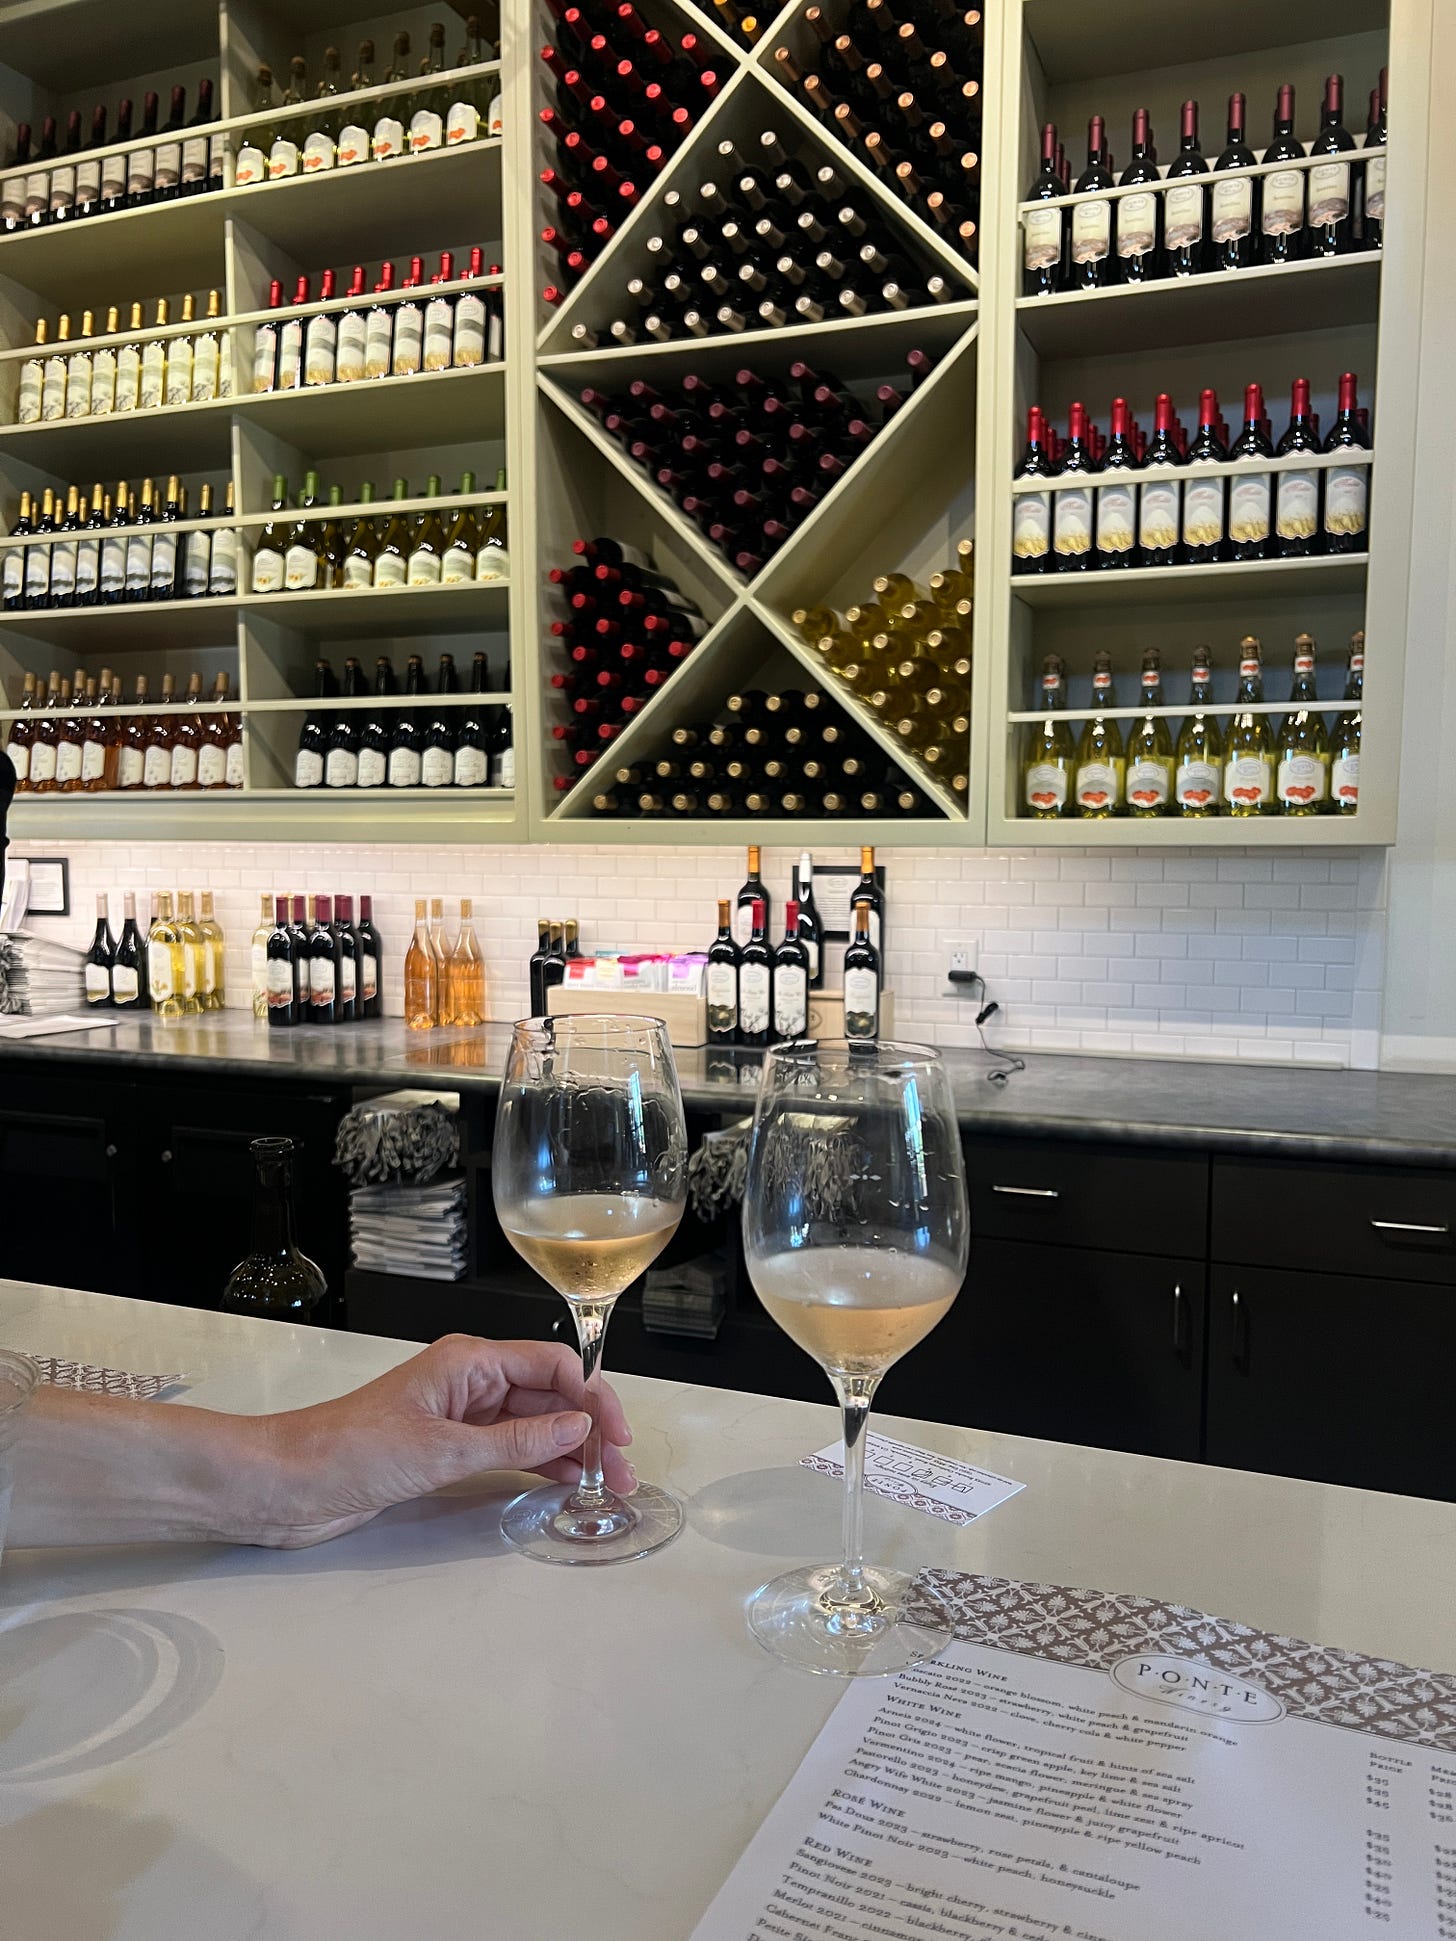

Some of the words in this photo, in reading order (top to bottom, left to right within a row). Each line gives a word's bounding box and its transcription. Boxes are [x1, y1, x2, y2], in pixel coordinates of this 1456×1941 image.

[886, 1694, 925, 1710] WHITE
[929, 1703, 963, 1719] WINE
[898, 1672, 932, 1686] Bubbly
[960, 1688, 987, 1700] 2023
[999, 1698, 1054, 1716] strawberry,
[1058, 1713, 1086, 1723] white
[1088, 1720, 1118, 1729] peach
[1122, 1723, 1129, 1731] &
[1132, 1727, 1188, 1741] grapefruit
[912, 1667, 943, 1678] oscato
[945, 1674, 972, 1685] 2022
[983, 1684, 1018, 1696] orange
[1068, 1705, 1095, 1714] white
[1098, 1712, 1128, 1720] peach
[1144, 1719, 1196, 1733] mandarin
[1200, 1731, 1238, 1746] orange
[976, 1668, 1009, 1682] WINE
[878, 1706, 912, 1719] Arneis
[914, 1715, 941, 1728] 2024
[954, 1726, 981, 1737] white
[1024, 1745, 1066, 1759] tropical
[1069, 1754, 1094, 1765] fruit
[1156, 1771, 1173, 1779] sea
[1176, 1776, 1195, 1784] salt
[894, 1681, 940, 1698] Vernaccia
[943, 1693, 968, 1704] Nera
[971, 1701, 998, 1712] 2022
[1043, 1719, 1077, 1733] cherry
[1079, 1729, 1100, 1737] cola
[1103, 1731, 1111, 1739] &
[1115, 1735, 1144, 1743] white
[1146, 1740, 1186, 1751] pepper
[863, 1736, 924, 1757] Vermentino
[928, 1755, 956, 1768] 2024
[969, 1767, 992, 1776] ripe
[1038, 1785, 1095, 1800] pineapple
[1111, 1798, 1142, 1809] white
[1145, 1804, 1182, 1818] flower
[867, 1726, 895, 1738] Pinot
[899, 1733, 921, 1744] Gris
[923, 1741, 952, 1755] 2023
[995, 1762, 1027, 1773] acacia
[1071, 1780, 1126, 1793] meringue
[1129, 1788, 1138, 1796] &
[1162, 1797, 1193, 1810] spray
[873, 1716, 901, 1728] Pinot
[904, 1723, 938, 1737] Grigio
[940, 1733, 968, 1747] 2023
[981, 1746, 1007, 1758] crisp
[1008, 1754, 1040, 1765] green
[1043, 1762, 1076, 1774] apple,
[1080, 1768, 1098, 1778] key
[1100, 1771, 1126, 1781] lime
[1129, 1776, 1137, 1784] &
[1141, 1780, 1159, 1788] sea
[1161, 1784, 1181, 1793] salt
[831, 1788, 865, 1806] ROSÉ
[870, 1799, 907, 1818] WINE
[844, 1768, 909, 1794] Chardonnay
[912, 1789, 942, 1802] 2022
[955, 1799, 991, 1815] lemon
[1022, 1819, 1081, 1835] pineapple
[1096, 1834, 1121, 1844] ripe
[1124, 1841, 1162, 1854] yellow
[1165, 1851, 1201, 1865] peach
[848, 1758, 881, 1772] Angry
[885, 1765, 908, 1778] Wife
[911, 1774, 942, 1789] White
[945, 1785, 975, 1799] 2023
[986, 1796, 1032, 1812] jasmine
[1035, 1807, 1072, 1820] flower
[1074, 1815, 1083, 1823] &
[1085, 1818, 1116, 1832] juicy
[1117, 1826, 1179, 1845] grapefruit
[856, 1747, 907, 1766] Pastorello
[909, 1762, 939, 1776] 2023
[1011, 1791, 1069, 1807] grapefruit
[1104, 1808, 1131, 1819] lime
[1133, 1816, 1155, 1825] zest
[1159, 1820, 1168, 1828] &
[1172, 1825, 1197, 1836] ripe
[1200, 1833, 1244, 1850] apricot
[804, 1836, 831, 1853] RED
[835, 1847, 873, 1868] WINE
[819, 1811, 850, 1828] White
[852, 1823, 883, 1839] Pinot
[886, 1834, 915, 1848] Noir
[917, 1844, 949, 1859] 2023
[963, 1856, 995, 1869] white
[1040, 1873, 1116, 1899] honeysuckle
[878, 1819, 908, 1834] 2023
[921, 1832, 983, 1853] strawberry,
[988, 1849, 1014, 1859] rose
[1059, 1863, 1068, 1872] &
[1071, 1869, 1140, 1891] cantaloupe
[756, 1917, 791, 1937] Petite
[766, 1903, 820, 1930] Cabernet
[773, 1888, 814, 1911] Merlot
[816, 1906, 847, 1922] 2021
[782, 1874, 855, 1908] Tempranillo
[858, 1904, 892, 1918] 2022
[789, 1861, 821, 1879] Pinot
[823, 1874, 853, 1889] Noir
[855, 1886, 885, 1900] 2021
[940, 1907, 1005, 1935] blackberry
[1008, 1926, 1017, 1936] &
[796, 1848, 857, 1875] Sangiovese
[859, 1872, 892, 1888] 2023
[905, 1882, 943, 1899] bright
[992, 1908, 1059, 1933] strawberry
[1062, 1924, 1072, 1934] &
